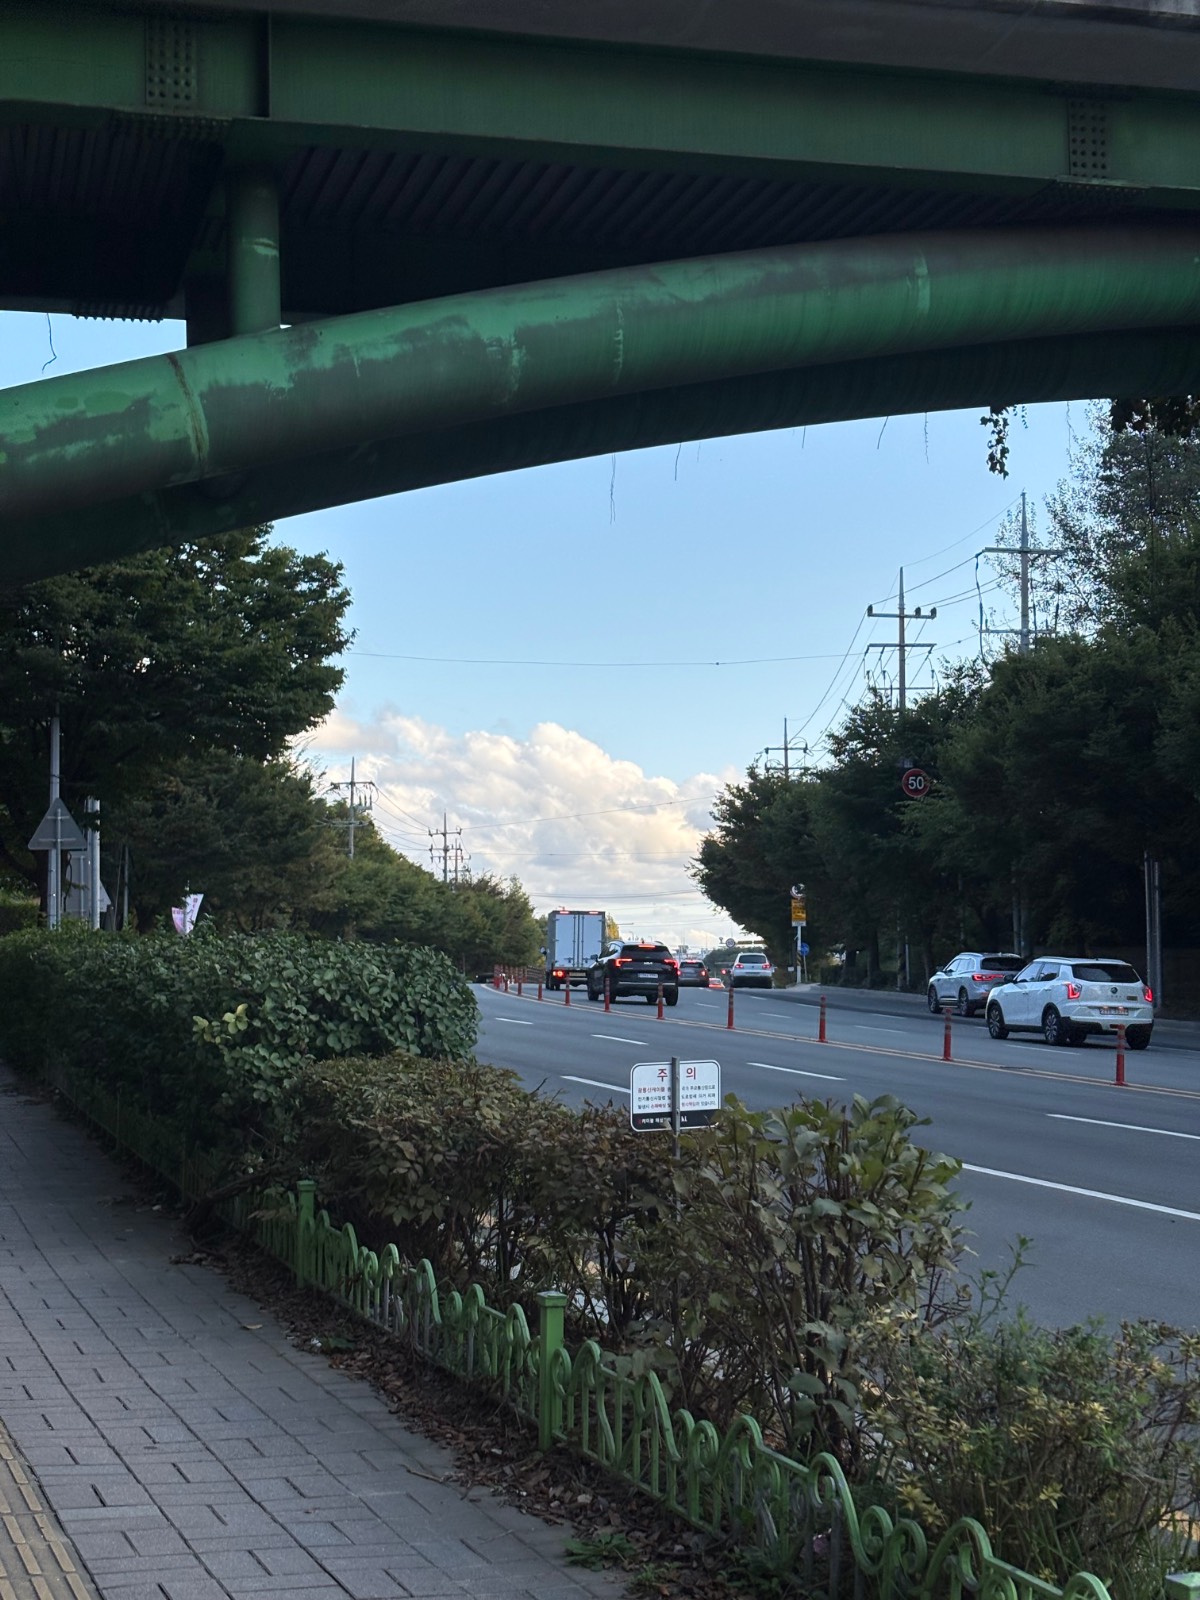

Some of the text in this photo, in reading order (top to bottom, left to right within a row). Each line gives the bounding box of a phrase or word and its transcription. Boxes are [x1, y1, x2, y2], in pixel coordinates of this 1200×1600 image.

[908, 776, 925, 790] 50
[657, 1066, 696, 1082] 주 의
